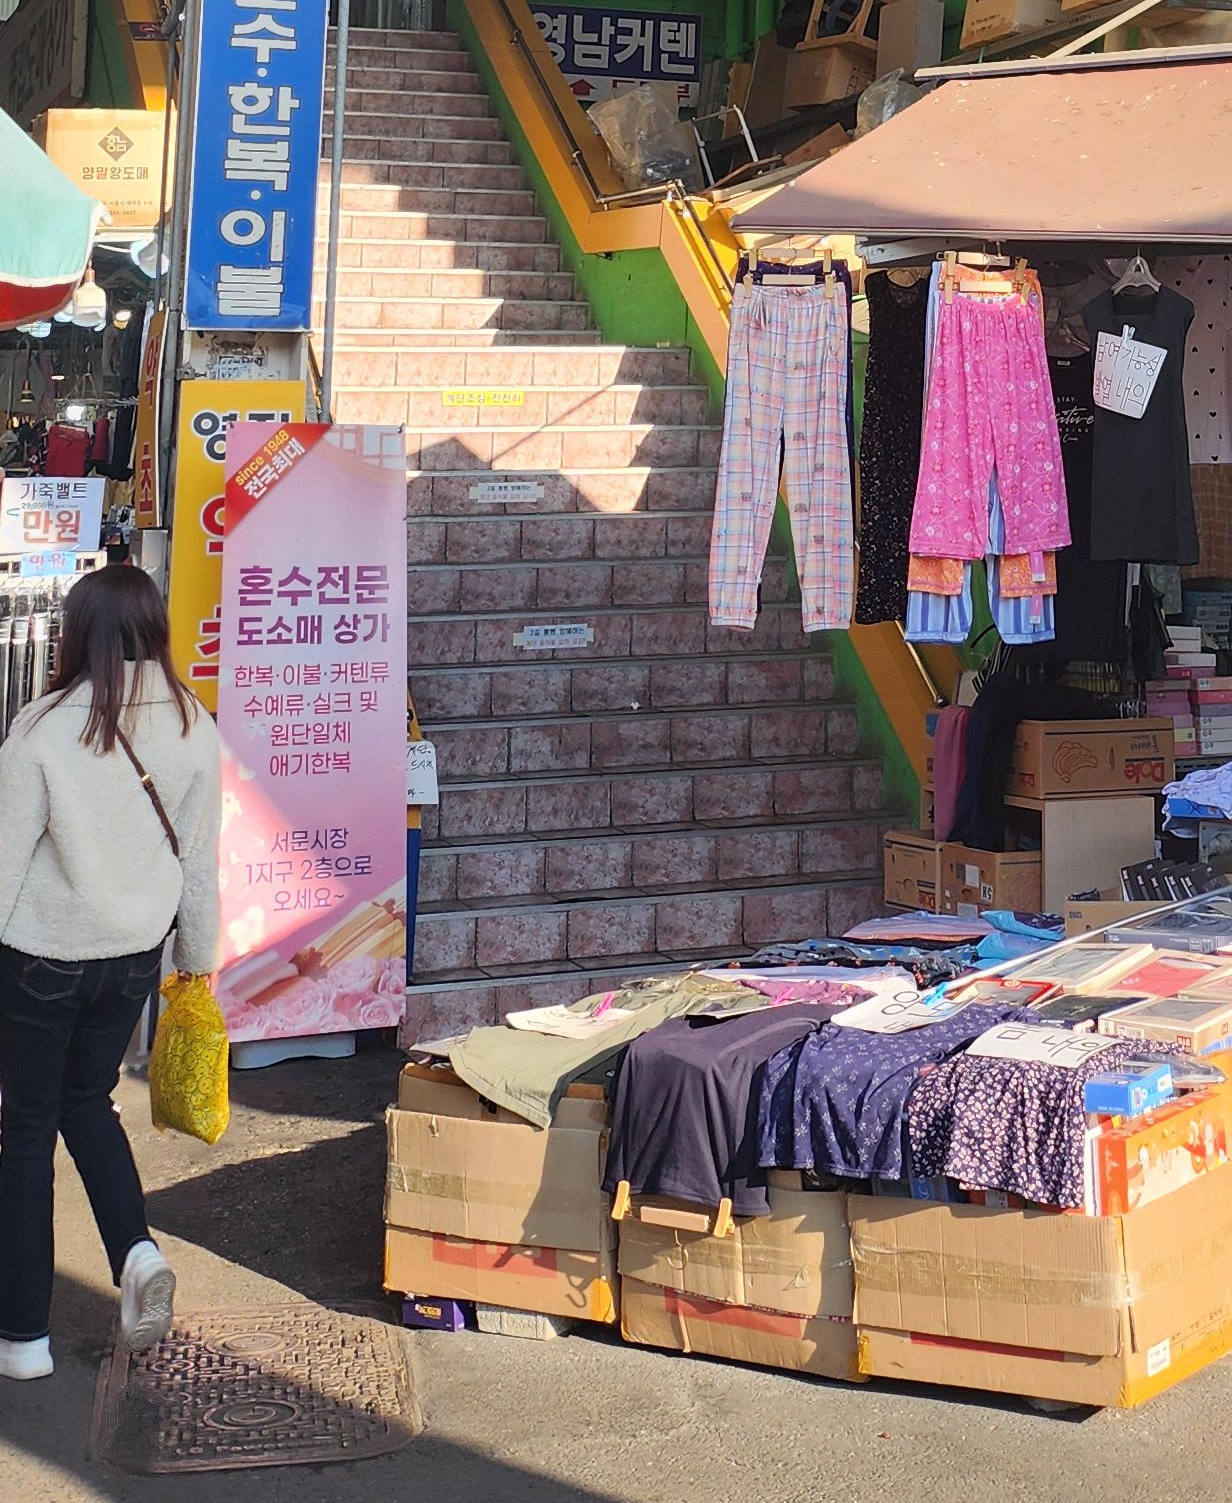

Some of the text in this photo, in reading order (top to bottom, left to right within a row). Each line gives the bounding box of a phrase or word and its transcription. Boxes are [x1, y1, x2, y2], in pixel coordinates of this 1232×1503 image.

[532, 12, 697, 75] 영남커텐
[82, 166, 149, 180] 양말왕도매
[235, 428, 290, 487] since 1948
[243, 436, 306, 499] 전국최대
[20, 482, 88, 500] 가죽밸트
[23, 510, 81, 544] 만원
[237, 565, 390, 607] 혼수전문
[236, 613, 391, 646] 도소매 상가
[360, 690, 378, 713] 및
[270, 721, 352, 747] 원단일체
[269, 751, 351, 777] 애기한복
[1123, 760, 1165, 784] Dole
[271, 828, 349, 853] 서문시장
[246, 855, 373, 885] 1지구 2층으로
[273, 887, 346, 913] 오세요~
